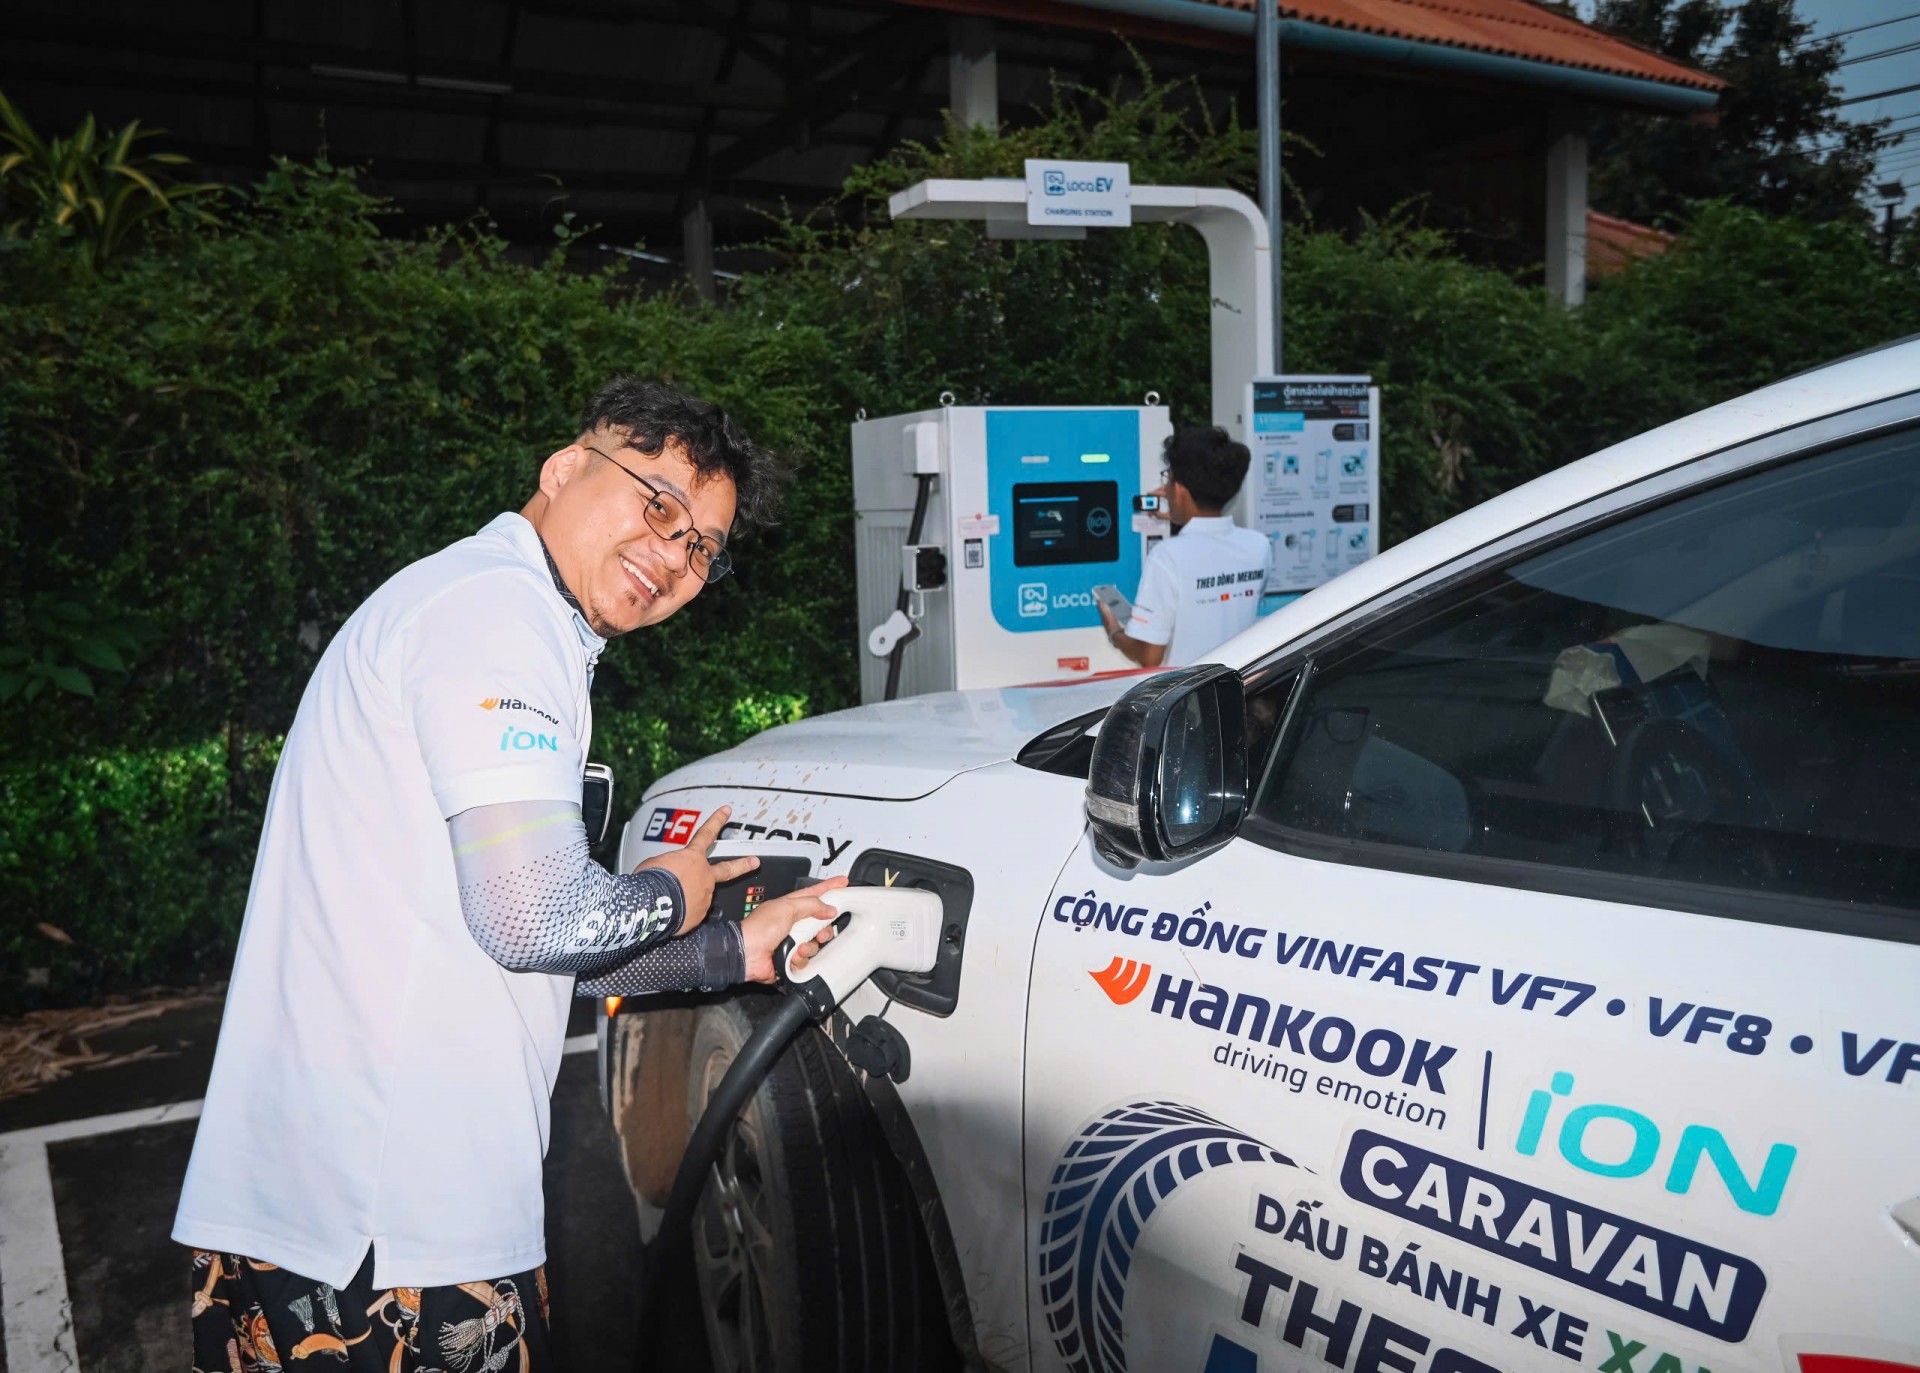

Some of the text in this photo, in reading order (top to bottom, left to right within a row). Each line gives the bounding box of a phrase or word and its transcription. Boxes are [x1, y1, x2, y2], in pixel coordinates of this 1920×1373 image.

[1044, 208, 1113, 217] CHARGING STATION
[1197, 577, 1215, 589] THEO
[1053, 890, 1149, 936] CỘNG
[1151, 901, 1268, 959] ĐỒNG
[1275, 932, 1482, 997] VINFAST
[1491, 967, 1597, 1018] VF7
[1648, 996, 1773, 1056] VF8
[1212, 1041, 1448, 1130] driving emotion
[1254, 1193, 1713, 1373] DẤU BÁNH XE XA
[1360, 1144, 1739, 1325] CARAVAN
